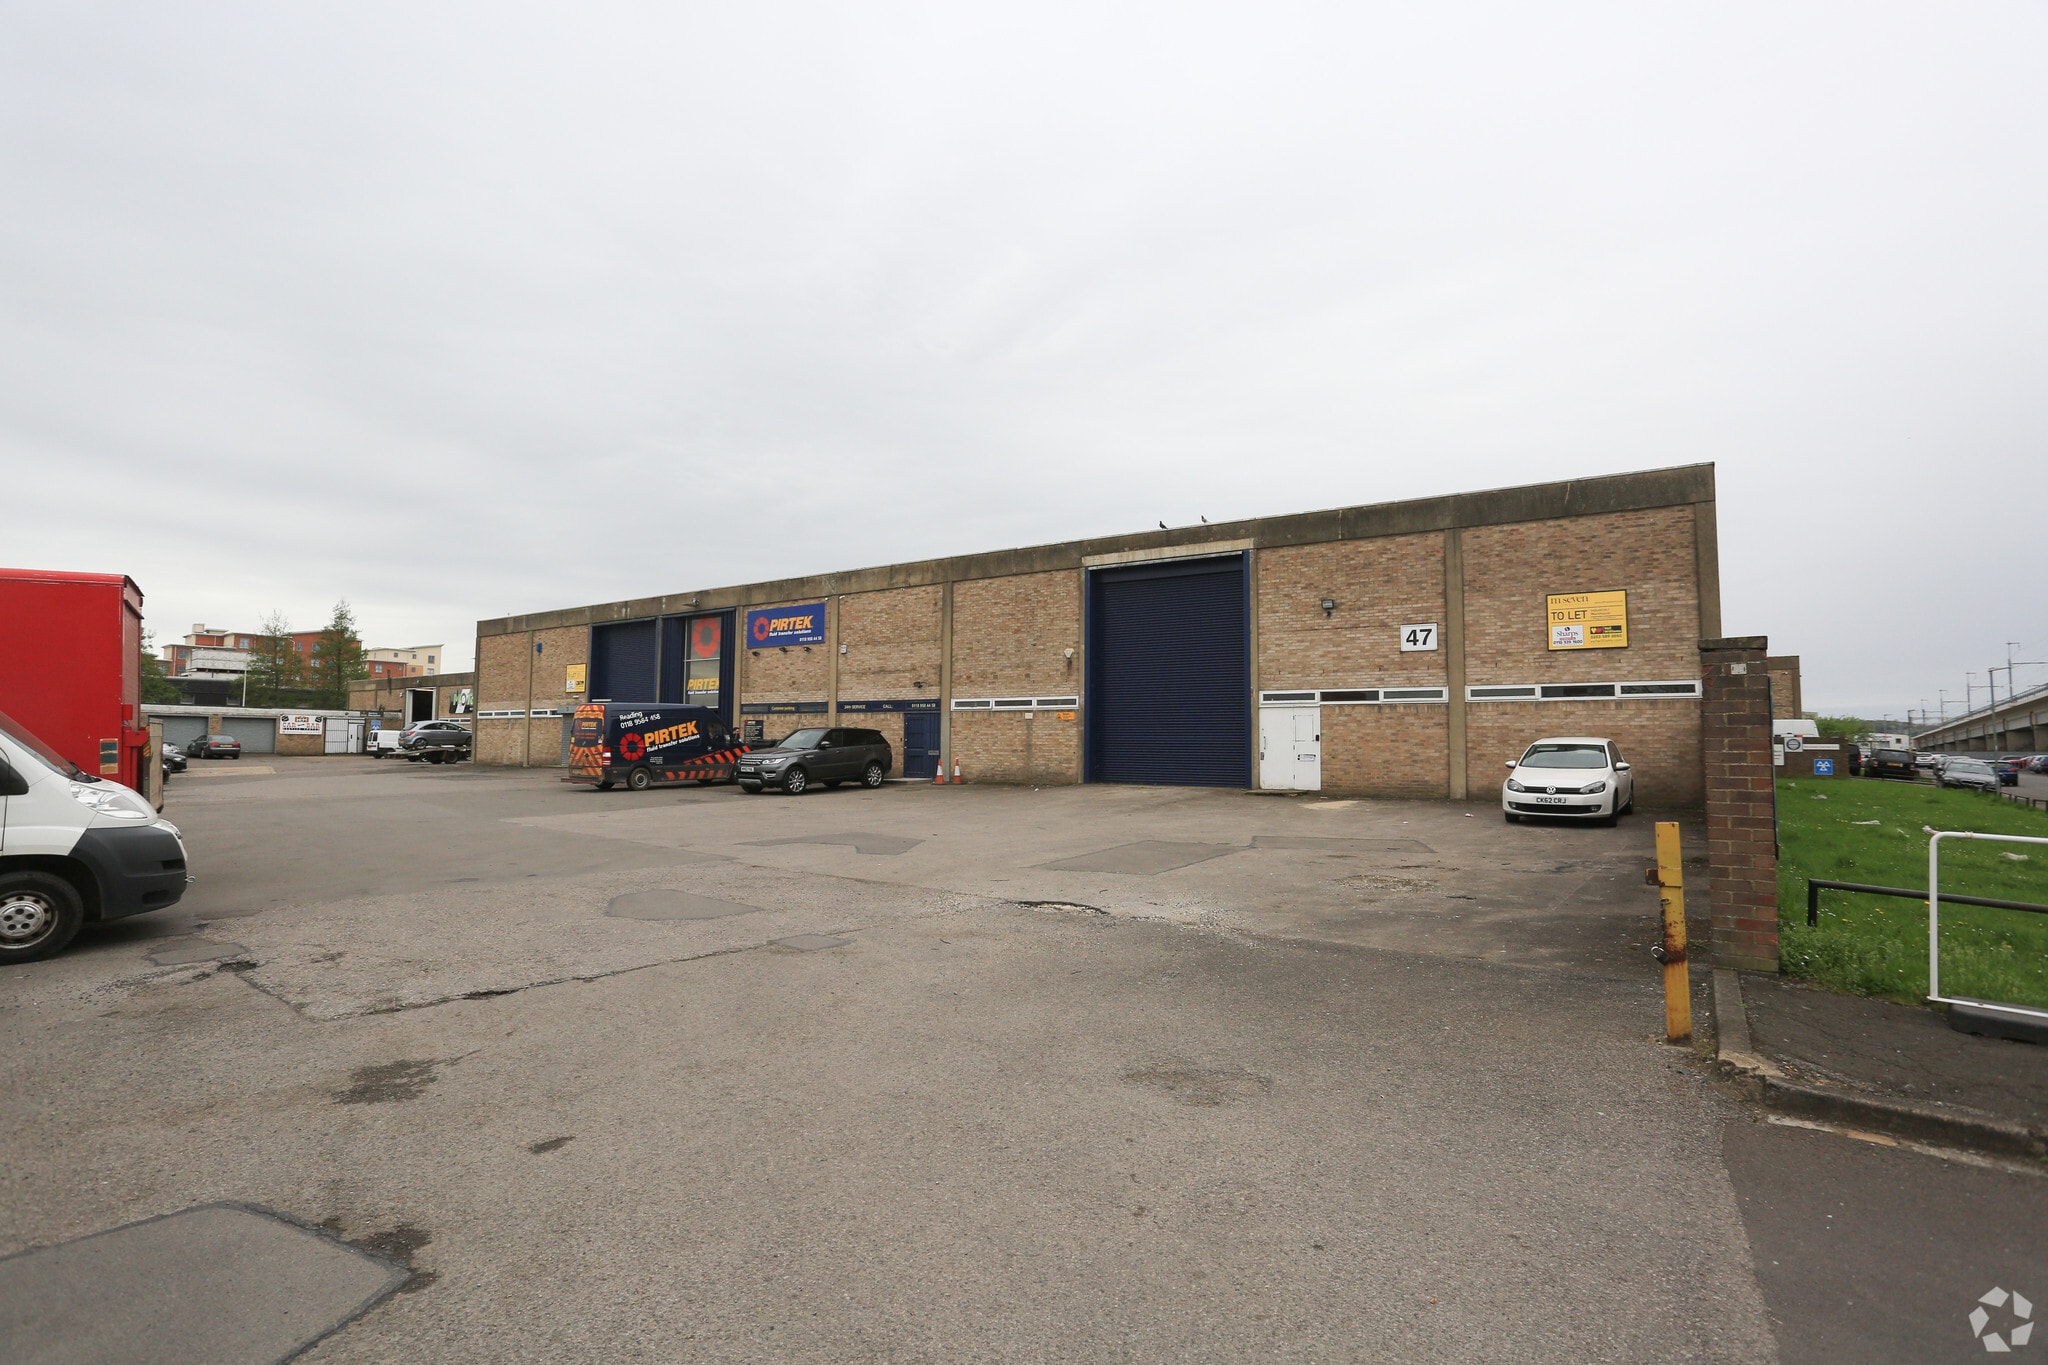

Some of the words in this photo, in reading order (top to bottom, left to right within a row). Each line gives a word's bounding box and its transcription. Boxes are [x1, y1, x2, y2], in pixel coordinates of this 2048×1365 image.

[769, 615, 814, 631] PIRTEK
[1551, 611, 1565, 621] TO
[1567, 610, 1588, 620] LET
[1406, 628, 1433, 646] 47
[619, 711, 643, 721] Reading
[620, 720, 634, 729] 0118
[643, 720, 699, 747] PIRTEK
[646, 744, 659, 753] fluid
[659, 740, 678, 749] transfer
[678, 734, 700, 744] solutions
